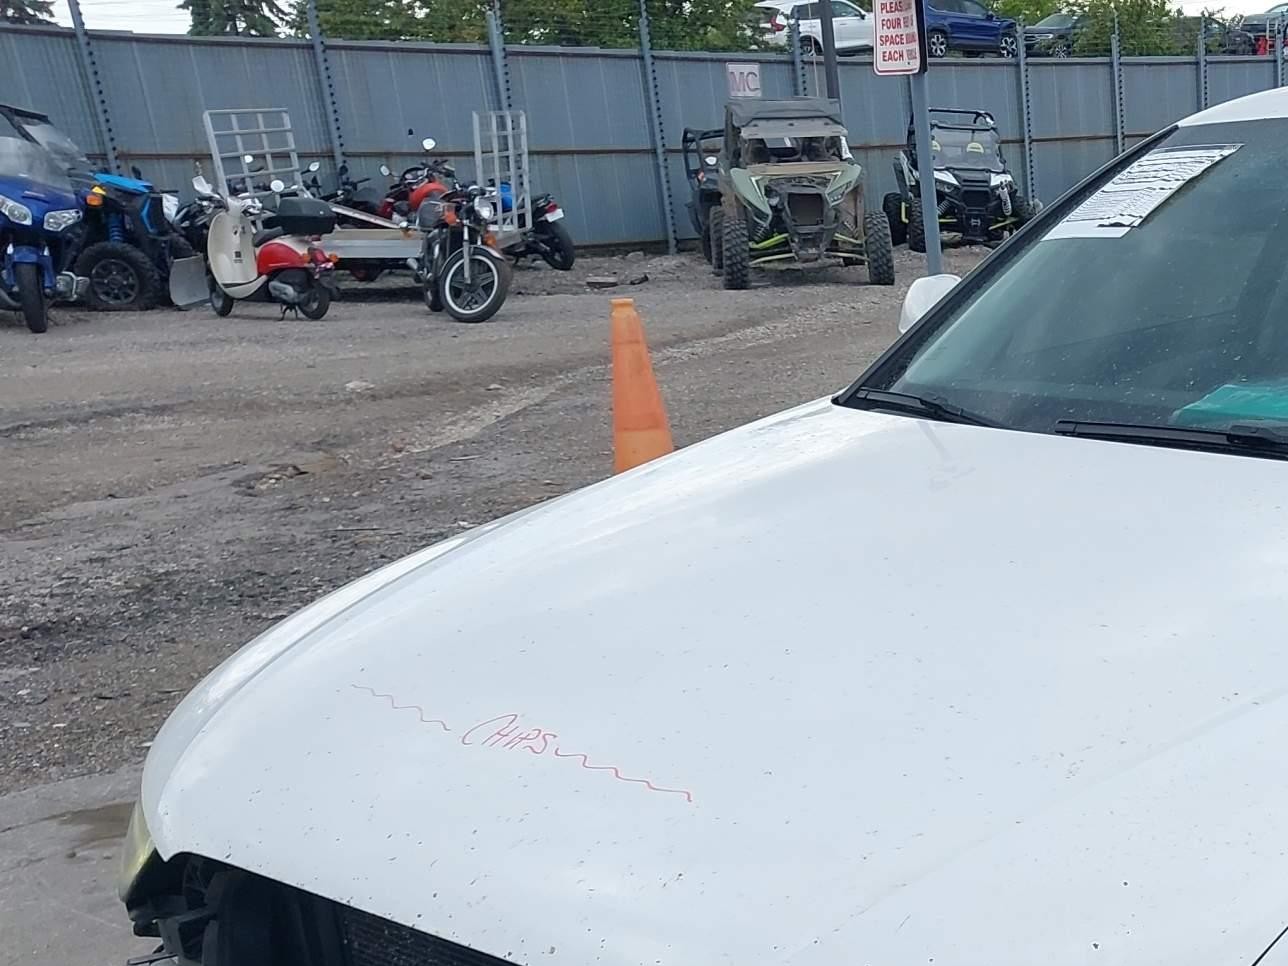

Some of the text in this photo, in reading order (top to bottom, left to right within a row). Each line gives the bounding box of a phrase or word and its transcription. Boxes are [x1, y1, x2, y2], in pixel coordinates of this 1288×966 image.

[881, 18, 902, 30] FOUR
[880, 34, 905, 46] SPACE
[882, 50, 904, 62] EACH
[729, 71, 760, 92] MC
[462, 713, 558, 755] CHIPS
